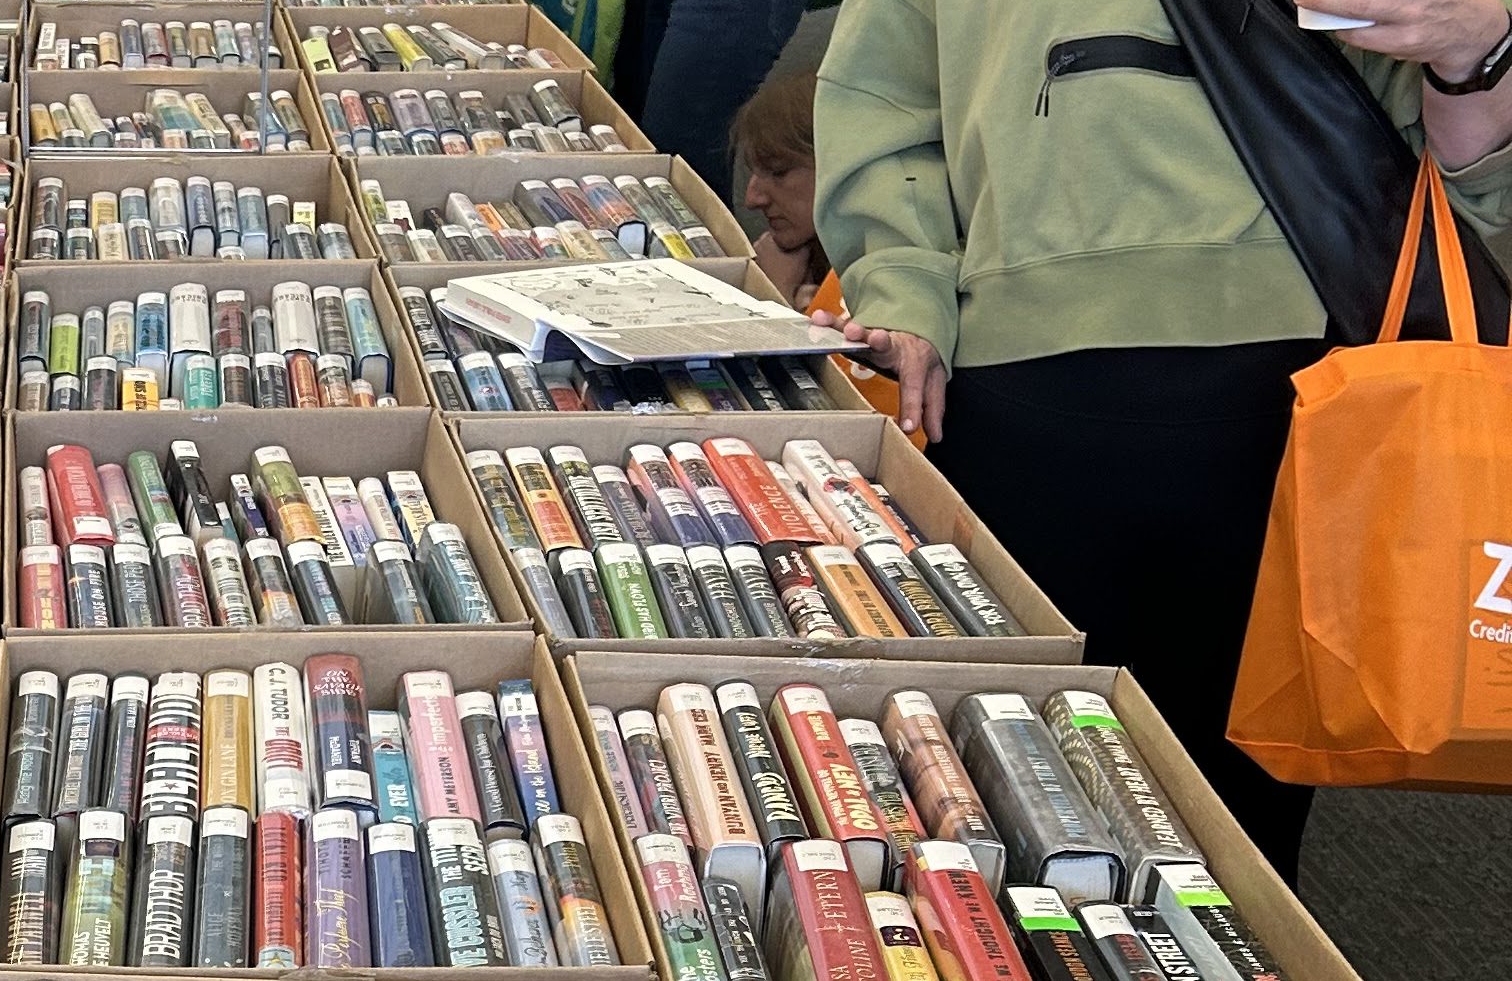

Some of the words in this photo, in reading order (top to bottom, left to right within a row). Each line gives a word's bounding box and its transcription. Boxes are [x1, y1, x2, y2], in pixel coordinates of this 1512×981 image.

[569, 475, 612, 521] SCOTTOLINE
[760, 485, 805, 533] VIOLENCE
[595, 522, 623, 542] LISA
[88, 570, 101, 585] FIRE
[126, 578, 149, 603] THOSE
[952, 572, 980, 588] OWN
[91, 588, 103, 600] ON
[627, 582, 647, 607] FLOWN
[899, 580, 941, 610] BROWN
[964, 589, 997, 608] YOUR
[93, 601, 107, 626] HOUSE
[182, 601, 209, 627] BRAD
[637, 607, 652, 622] HAS
[977, 609, 1005, 625] FOR
[270, 688, 290, 720] TUDOR
[422, 695, 449, 745] imperfects
[699, 724, 717, 747] MARK
[220, 743, 237, 767] LANE
[262, 739, 304, 772] DRIFT
[703, 751, 732, 781] HENRY
[1106, 745, 1134, 764] EMMA
[220, 769, 237, 786] GIN
[437, 756, 456, 795] MEYERSON
[649, 759, 674, 793] PROJECT
[829, 762, 861, 789] NEV
[1026, 757, 1056, 781] THIRST
[1116, 767, 1151, 793] HEART
[219, 787, 237, 803] ON
[387, 784, 410, 807] EVER
[442, 797, 460, 814] AMY
[1133, 794, 1158, 806] BY
[720, 794, 745, 835] BUNYAN
[848, 796, 879, 830] OPAL
[966, 815, 985, 832] MARY
[1144, 806, 1184, 848] LEARNED
[442, 865, 463, 882] THE
[653, 869, 678, 891] Tom
[947, 870, 976, 900] KNEW
[146, 869, 185, 909] THOR
[313, 888, 358, 914] Thief
[9, 890, 45, 946] PARNELL
[439, 885, 486, 949] CUSSLER
[574, 904, 604, 935] STEEL
[967, 901, 982, 913] WE
[92, 916, 111, 959] HEUVELT
[143, 909, 181, 958] BRAD
[320, 915, 360, 959] Perfume
[971, 916, 1005, 960] THOUGHT
[73, 931, 90, 965] HOMAS
[1143, 931, 1195, 975] STREET
[1240, 947, 1265, 972] JAMES
[995, 964, 1011, 976] WE
[1059, 957, 1088, 981] ONDON
